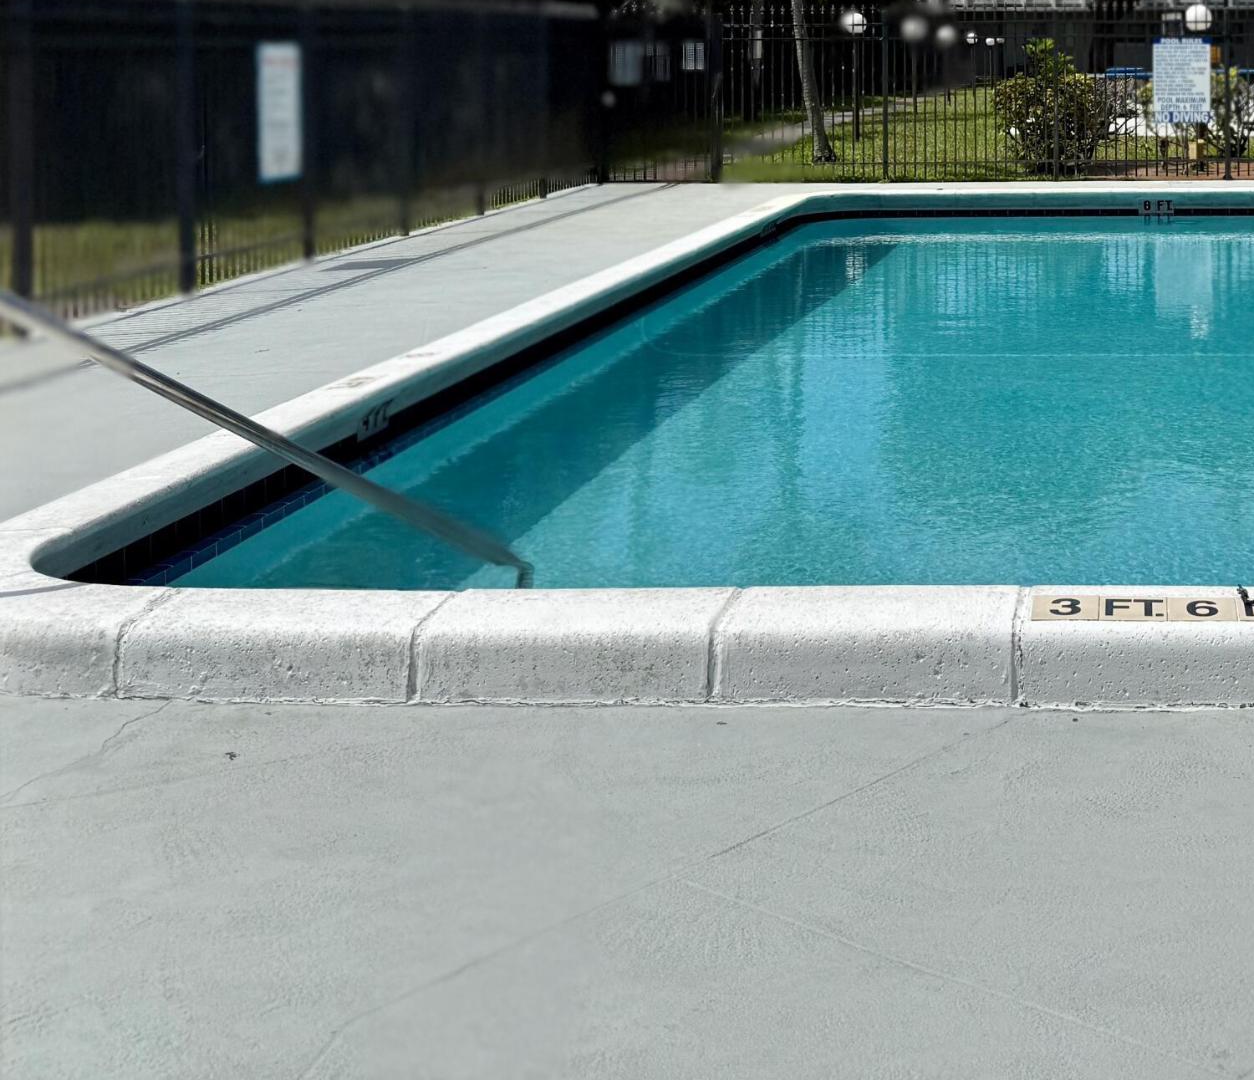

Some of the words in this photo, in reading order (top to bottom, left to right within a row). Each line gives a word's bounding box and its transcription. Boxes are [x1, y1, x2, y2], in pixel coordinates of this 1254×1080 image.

[1155, 111, 1170, 122] NO
[1172, 111, 1209, 123] DIVING
[1049, 598, 1082, 617] 3
[1104, 598, 1164, 617] FT.
[1186, 600, 1219, 618] 6
